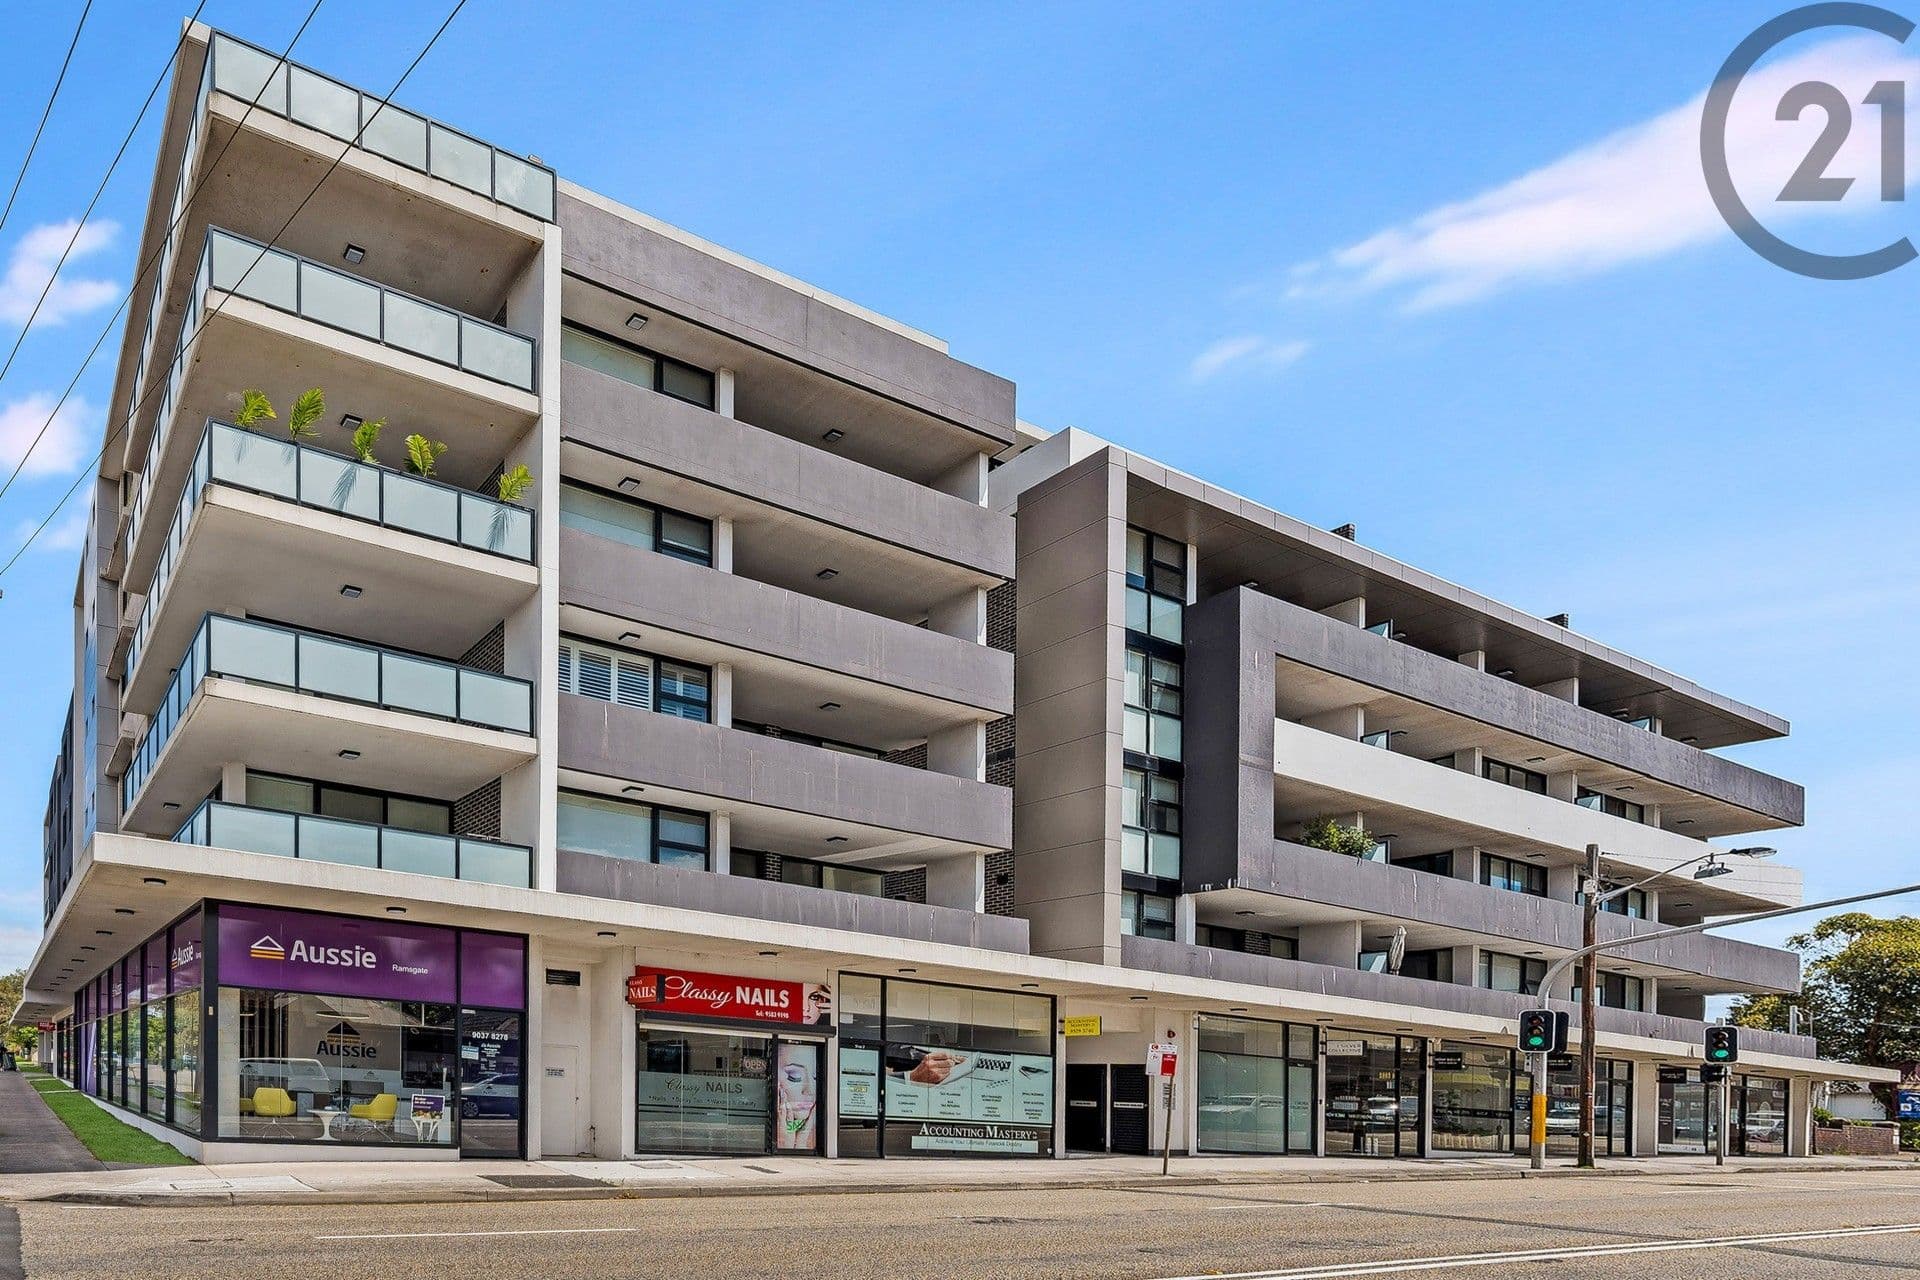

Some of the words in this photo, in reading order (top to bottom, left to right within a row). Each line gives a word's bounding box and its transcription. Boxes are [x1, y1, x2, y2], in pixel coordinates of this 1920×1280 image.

[177, 941, 194, 967] Aussie
[290, 940, 377, 969] Aussie
[392, 964, 429, 975] Ramsgate
[629, 986, 657, 999] NAILS
[664, 976, 734, 1008] Classy
[736, 986, 790, 1009] NAILS
[472, 1031, 490, 1040] 9037
[316, 1040, 377, 1059] Aussie
[705, 1082, 744, 1095] NAILS
[919, 1122, 984, 1138] ACCOUNTING
[985, 1125, 1031, 1140] MASTERY
